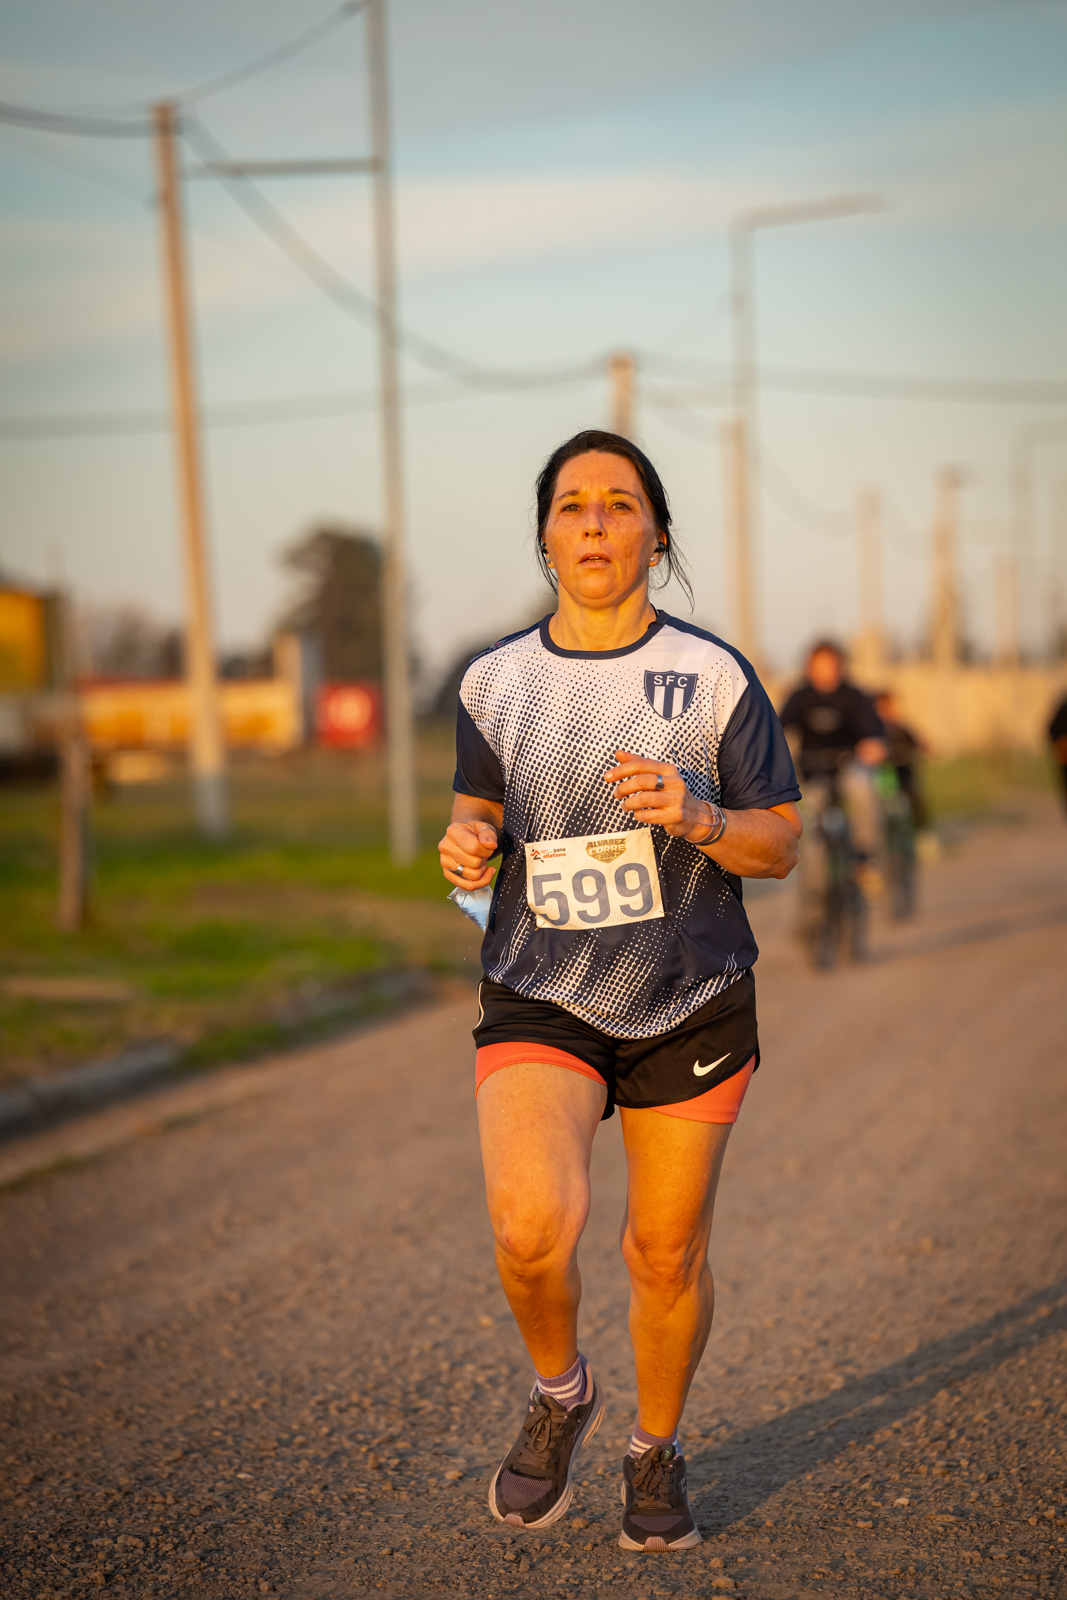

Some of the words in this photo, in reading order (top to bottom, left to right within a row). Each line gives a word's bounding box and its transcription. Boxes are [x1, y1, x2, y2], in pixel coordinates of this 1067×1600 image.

[653, 674, 688, 688] SFC
[587, 838, 626, 849] ALVAREZ
[588, 844, 625, 855] CORRE
[532, 862, 654, 926] 599
